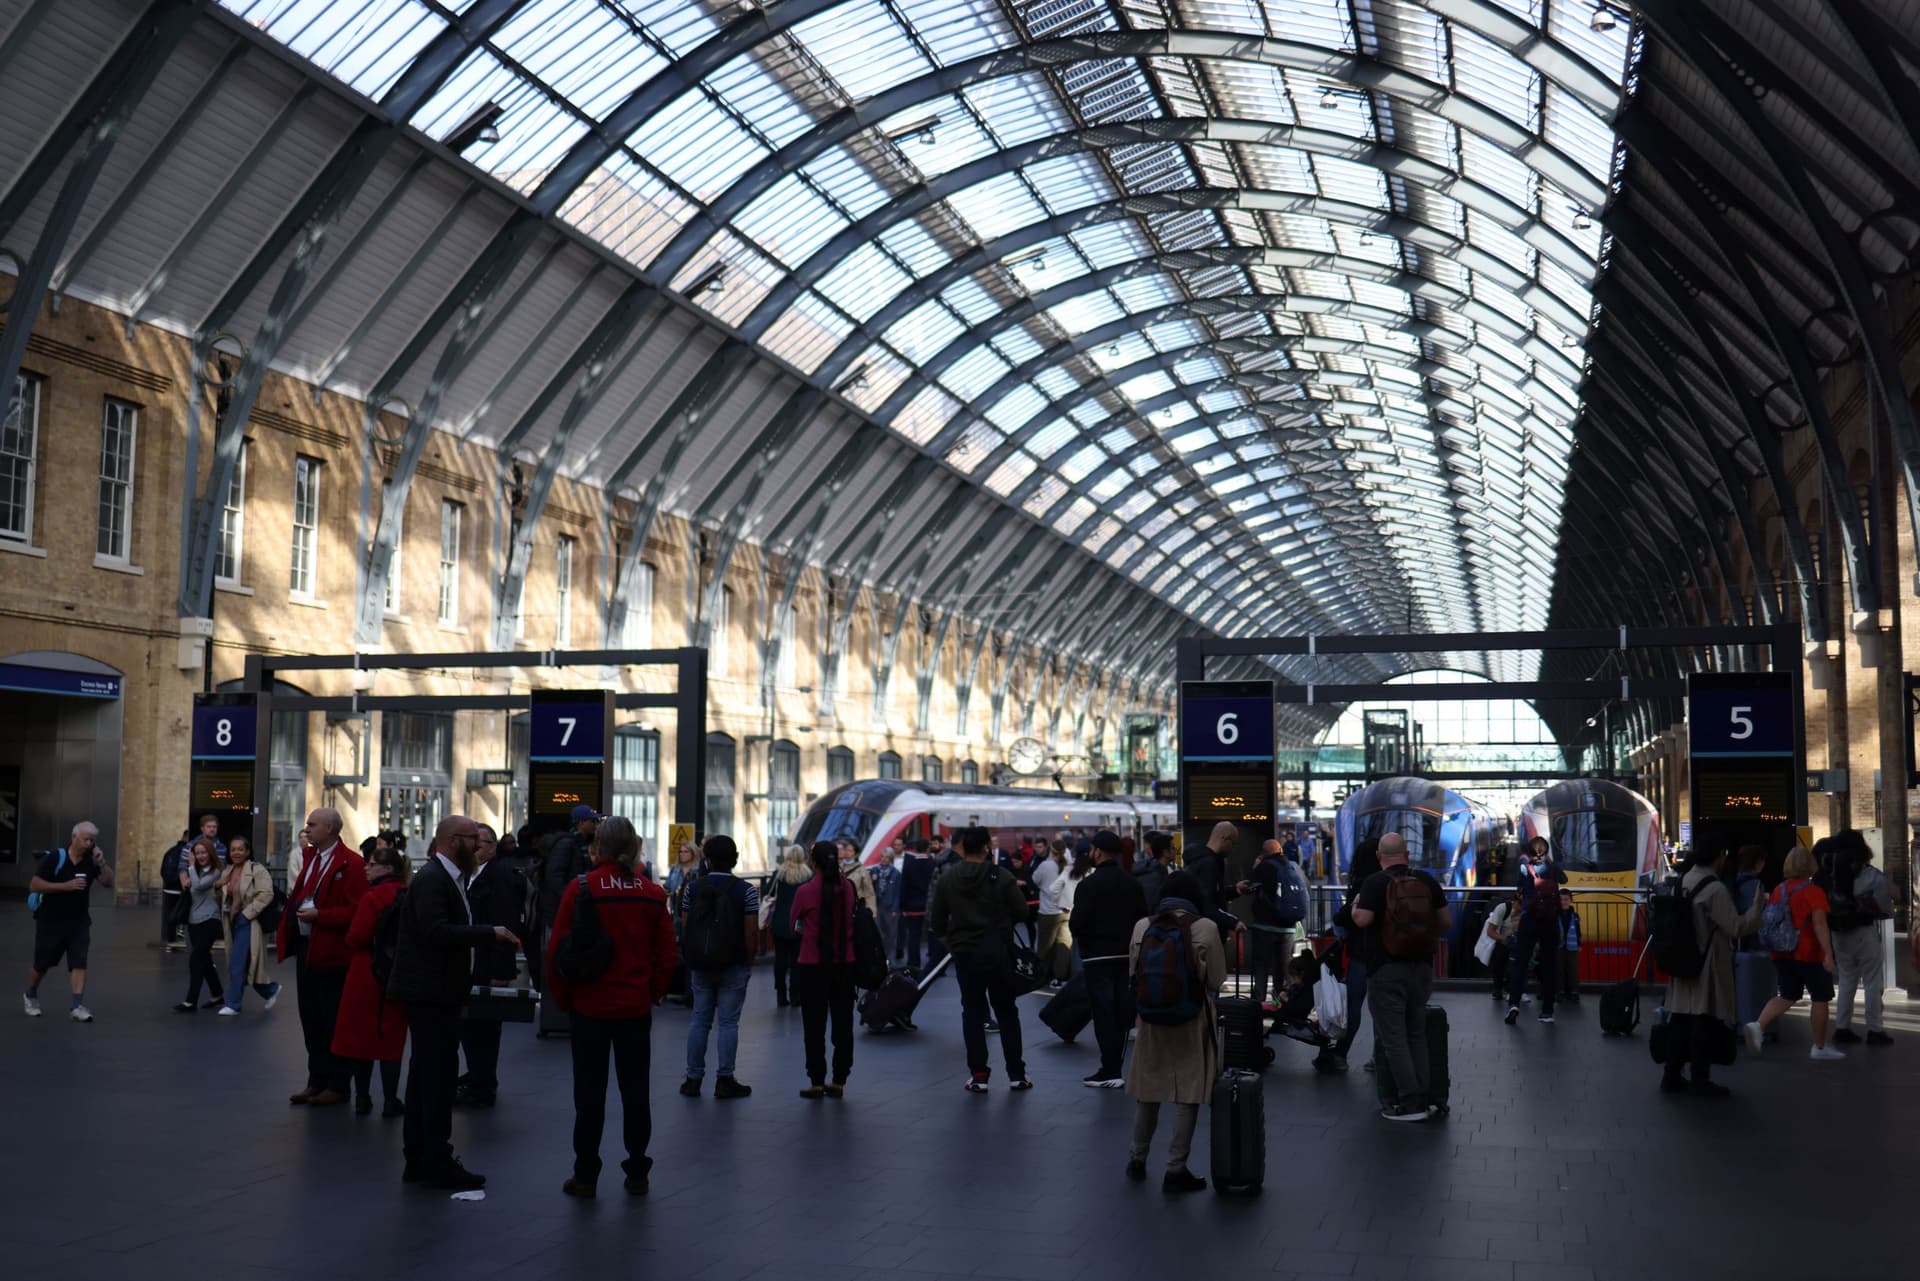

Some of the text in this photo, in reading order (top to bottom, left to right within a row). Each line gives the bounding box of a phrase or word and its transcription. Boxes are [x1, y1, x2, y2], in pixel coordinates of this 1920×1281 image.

[215, 718, 232, 747] 8
[557, 716, 577, 747] 7
[1216, 712, 1239, 745] 6
[1729, 706, 1754, 739] 5
[600, 873, 643, 890] LNER
